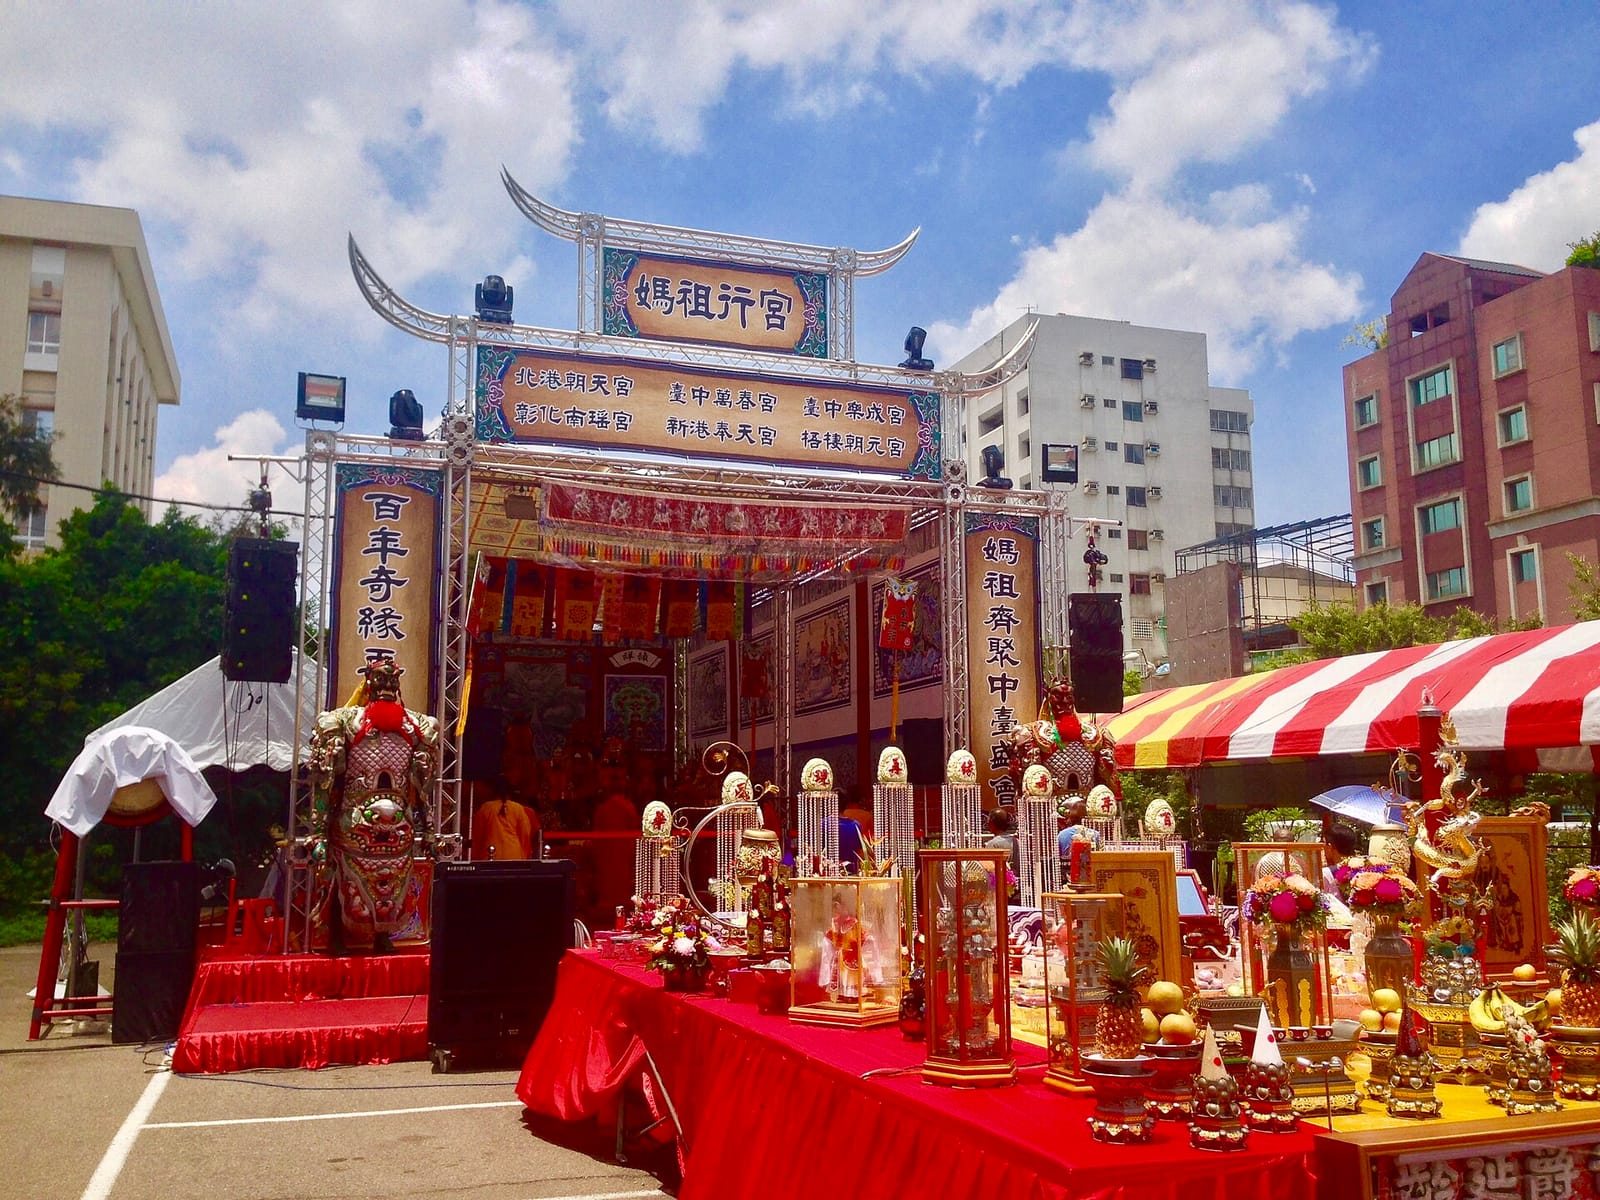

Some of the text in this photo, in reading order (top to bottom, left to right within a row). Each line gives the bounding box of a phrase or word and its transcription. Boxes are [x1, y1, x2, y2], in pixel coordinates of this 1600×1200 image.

[634, 273, 793, 331] 媽祖行宮
[514, 367, 905, 425] 北港朝天宮 臺中萬春宮 臺中樂成宮
[514, 402, 905, 457] 彰化南瑤宮 新港奉天宮 梧棲朝元宮
[982, 536, 1020, 807] 媽祖齊聚中臺盛會
